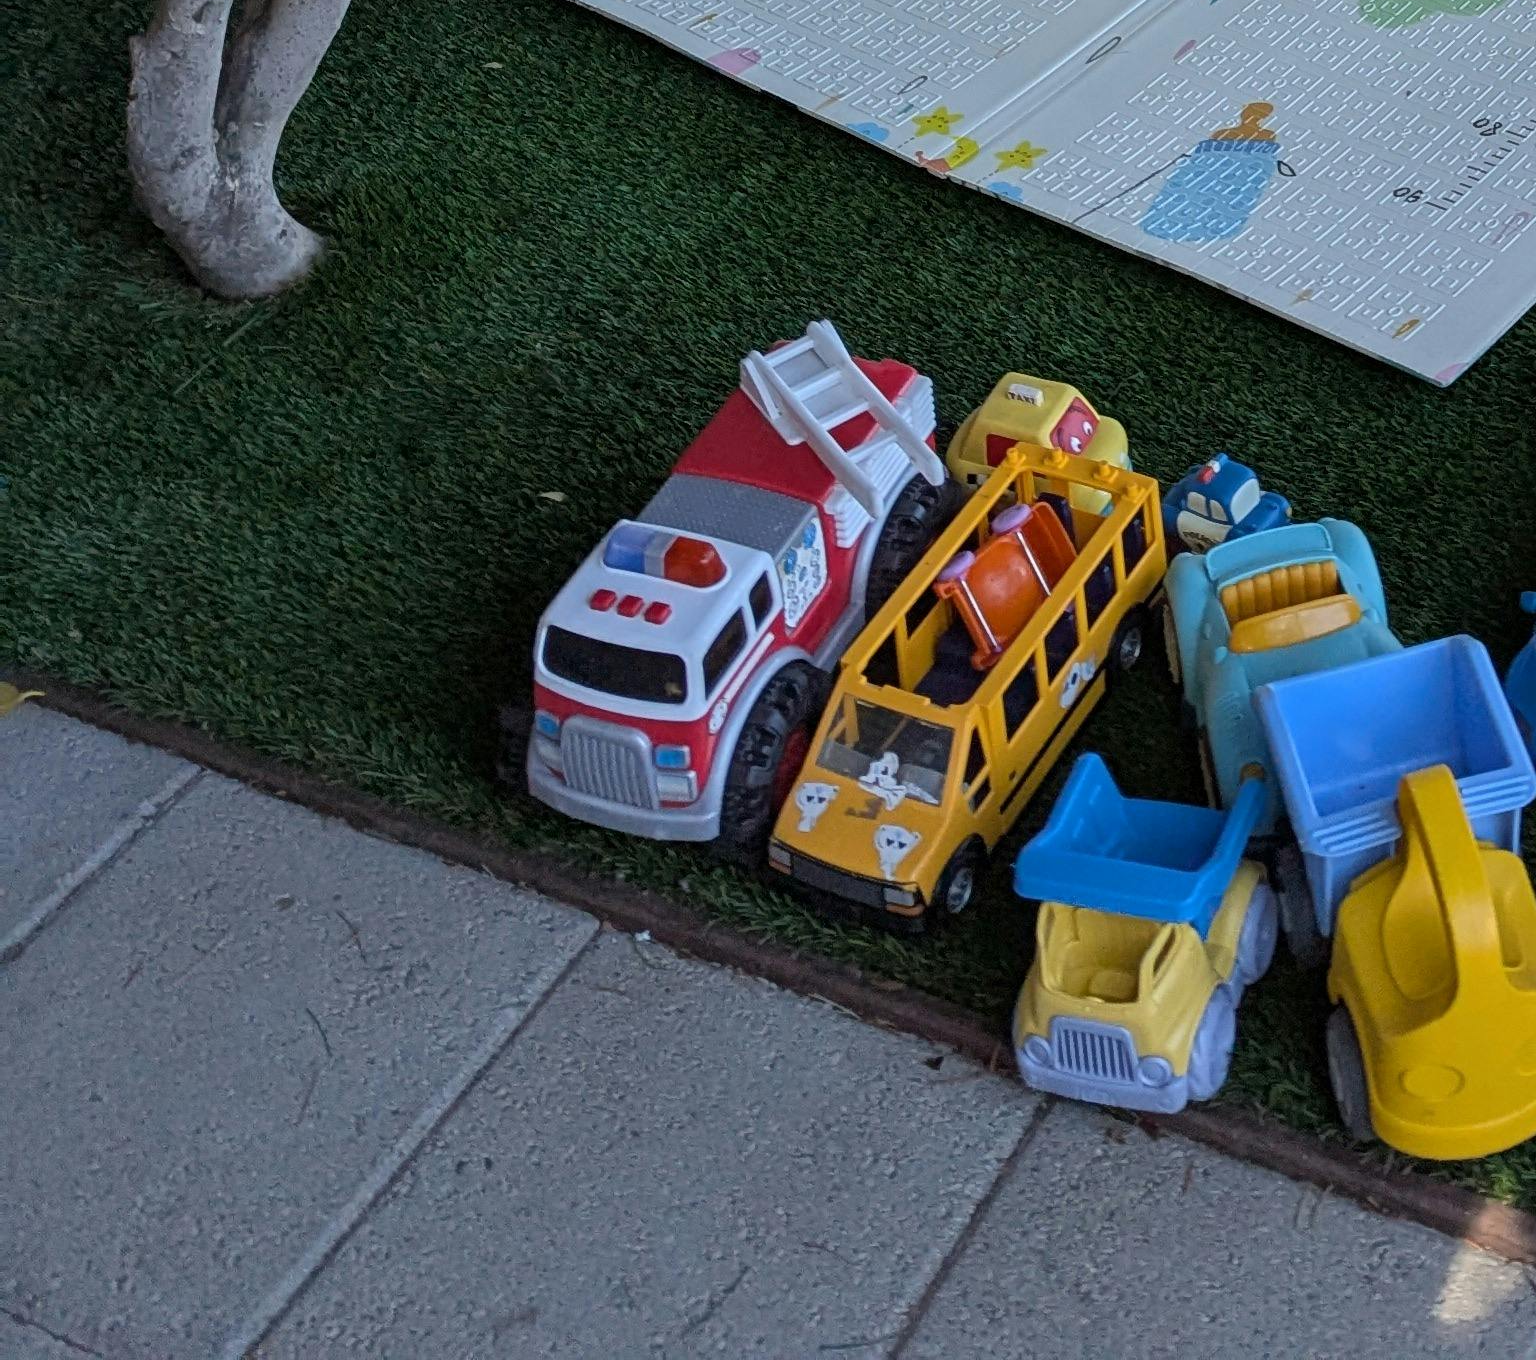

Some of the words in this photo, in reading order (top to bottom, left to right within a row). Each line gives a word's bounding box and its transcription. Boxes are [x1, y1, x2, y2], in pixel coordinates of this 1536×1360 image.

[1472, 118, 1502, 136] 80
[1393, 188, 1424, 203] 90
[1008, 391, 1035, 405] TAXI
